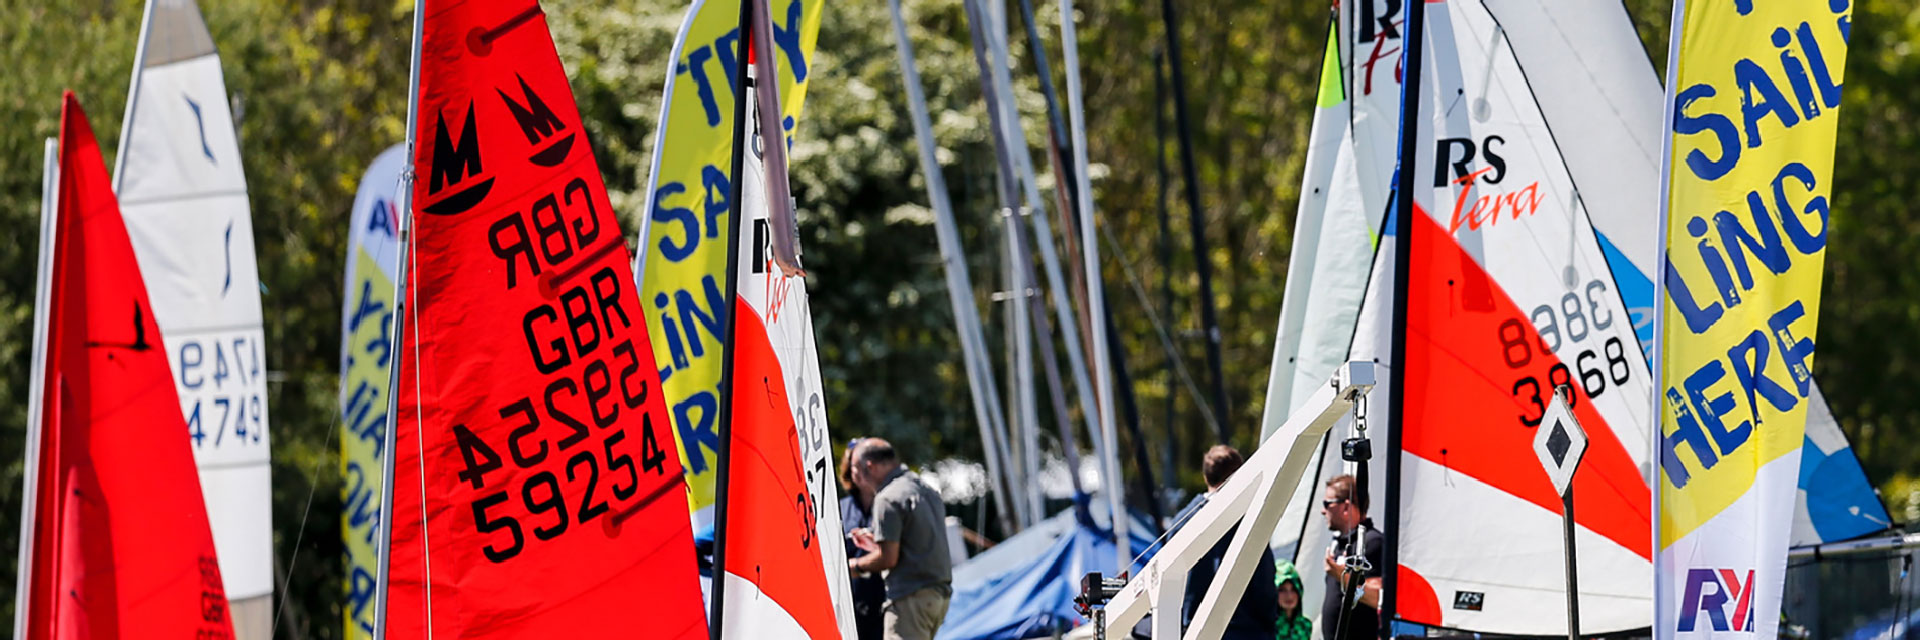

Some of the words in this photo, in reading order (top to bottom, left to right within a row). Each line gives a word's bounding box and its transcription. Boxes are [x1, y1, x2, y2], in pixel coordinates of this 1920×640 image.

[1433, 135, 1507, 188] RS
[1449, 166, 1546, 237] Tera
[523, 267, 630, 374] GBR
[187, 394, 261, 448] 4749
[1513, 337, 1629, 427] 3868
[1660, 300, 1816, 490] HERE
[471, 412, 666, 563] 59254
